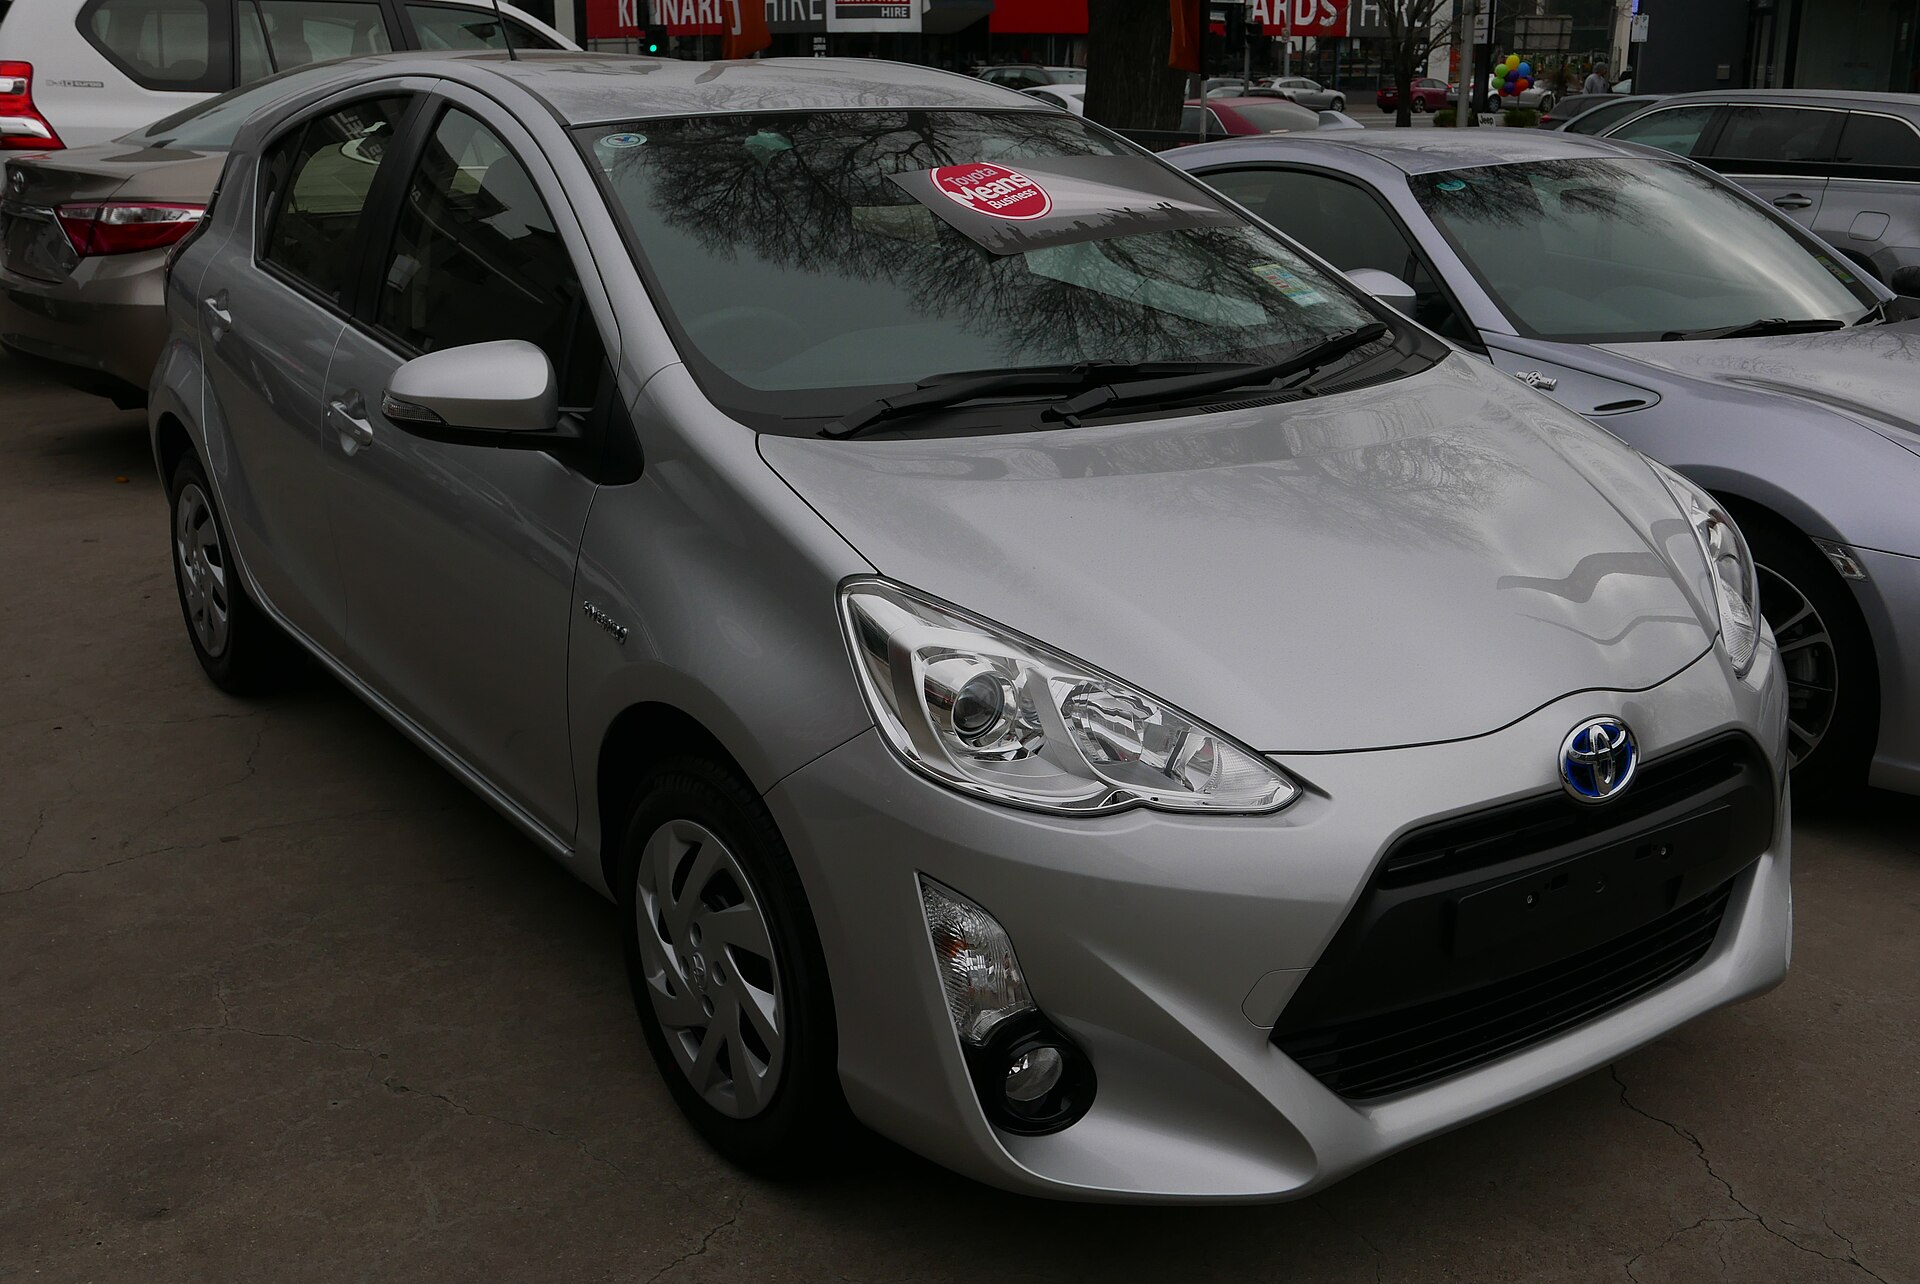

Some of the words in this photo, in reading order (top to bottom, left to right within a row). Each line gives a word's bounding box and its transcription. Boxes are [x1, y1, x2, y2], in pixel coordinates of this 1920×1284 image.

[881, 6, 908, 18] HIRE
[1479, 114, 1494, 126] Jeep
[943, 167, 999, 187] Toyota
[947, 173, 1033, 207] Means
[986, 188, 1038, 210] Business
